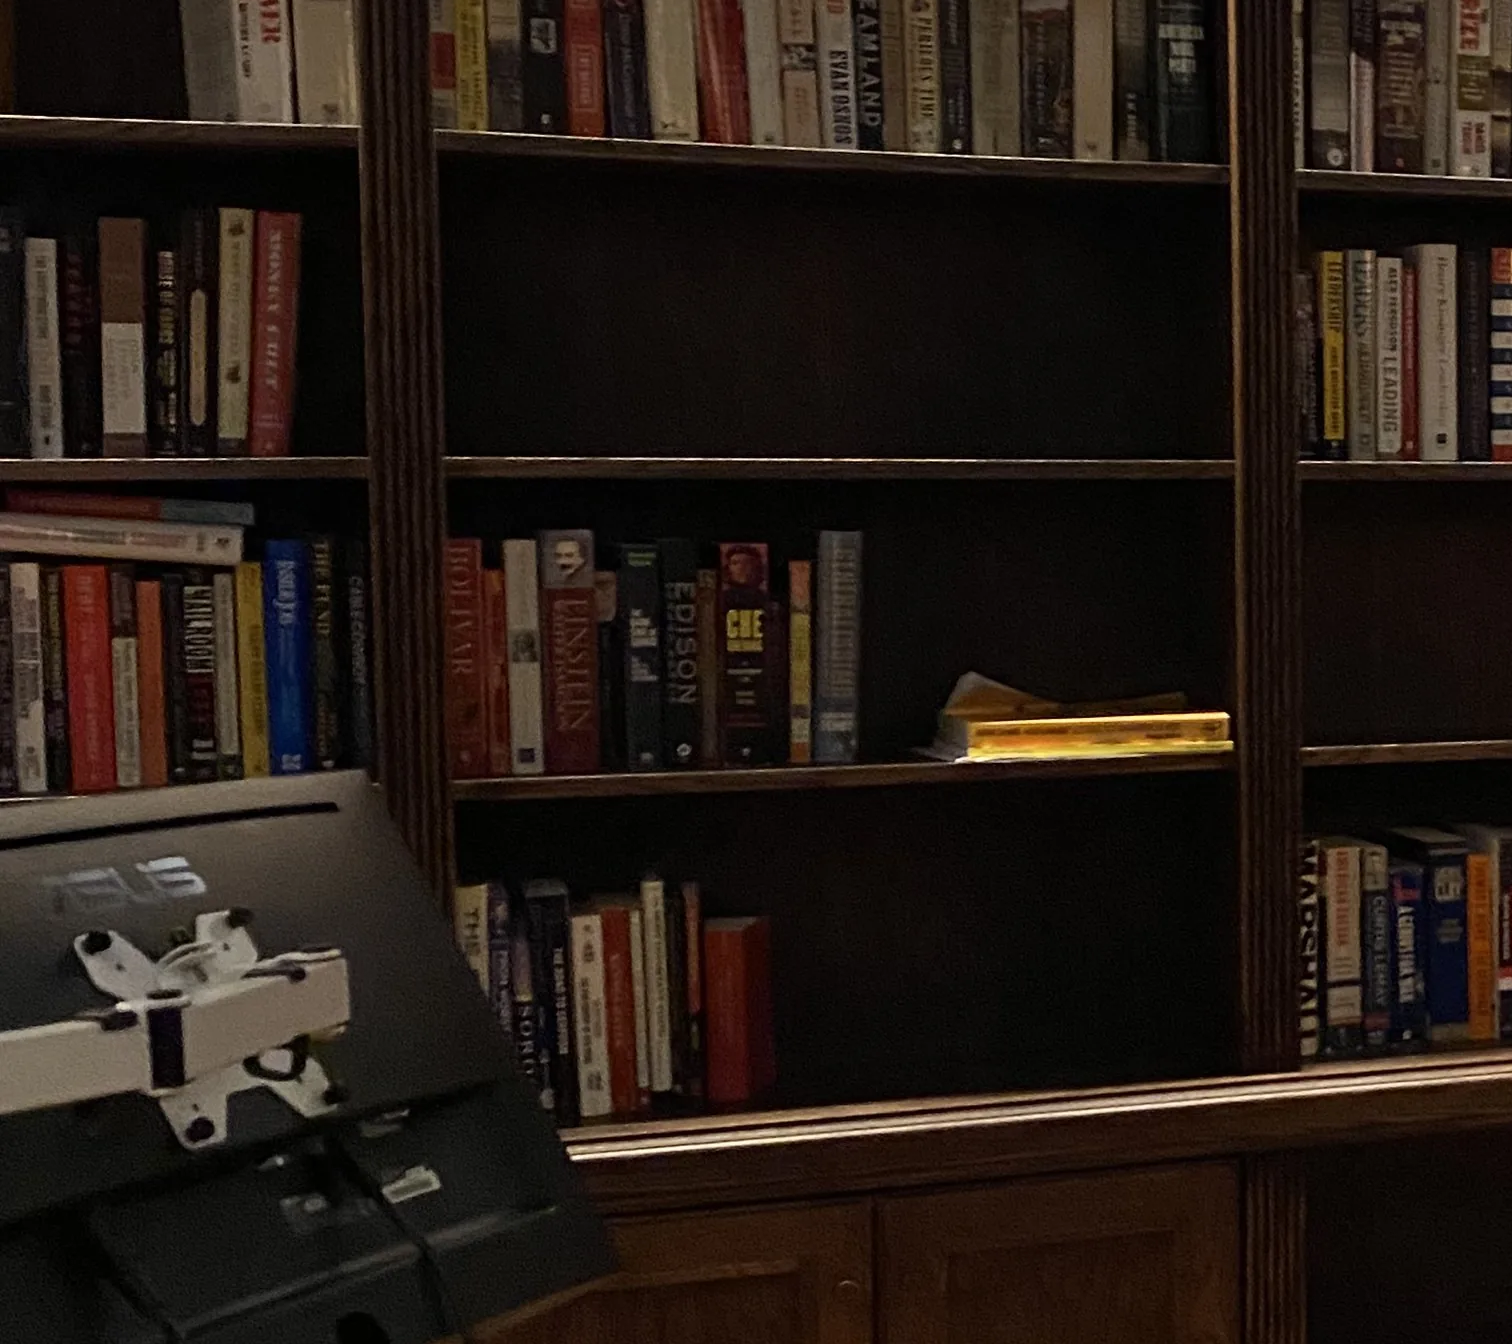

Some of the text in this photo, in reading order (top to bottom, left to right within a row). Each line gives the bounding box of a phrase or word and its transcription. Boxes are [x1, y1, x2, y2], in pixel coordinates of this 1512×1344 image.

[828, 49, 850, 90] EVAN
[832, 95, 853, 145] OSNOS
[1327, 261, 1343, 333] LEADERSHIP
[1383, 356, 1398, 432] LEADING
[675, 581, 697, 704] EDISON
